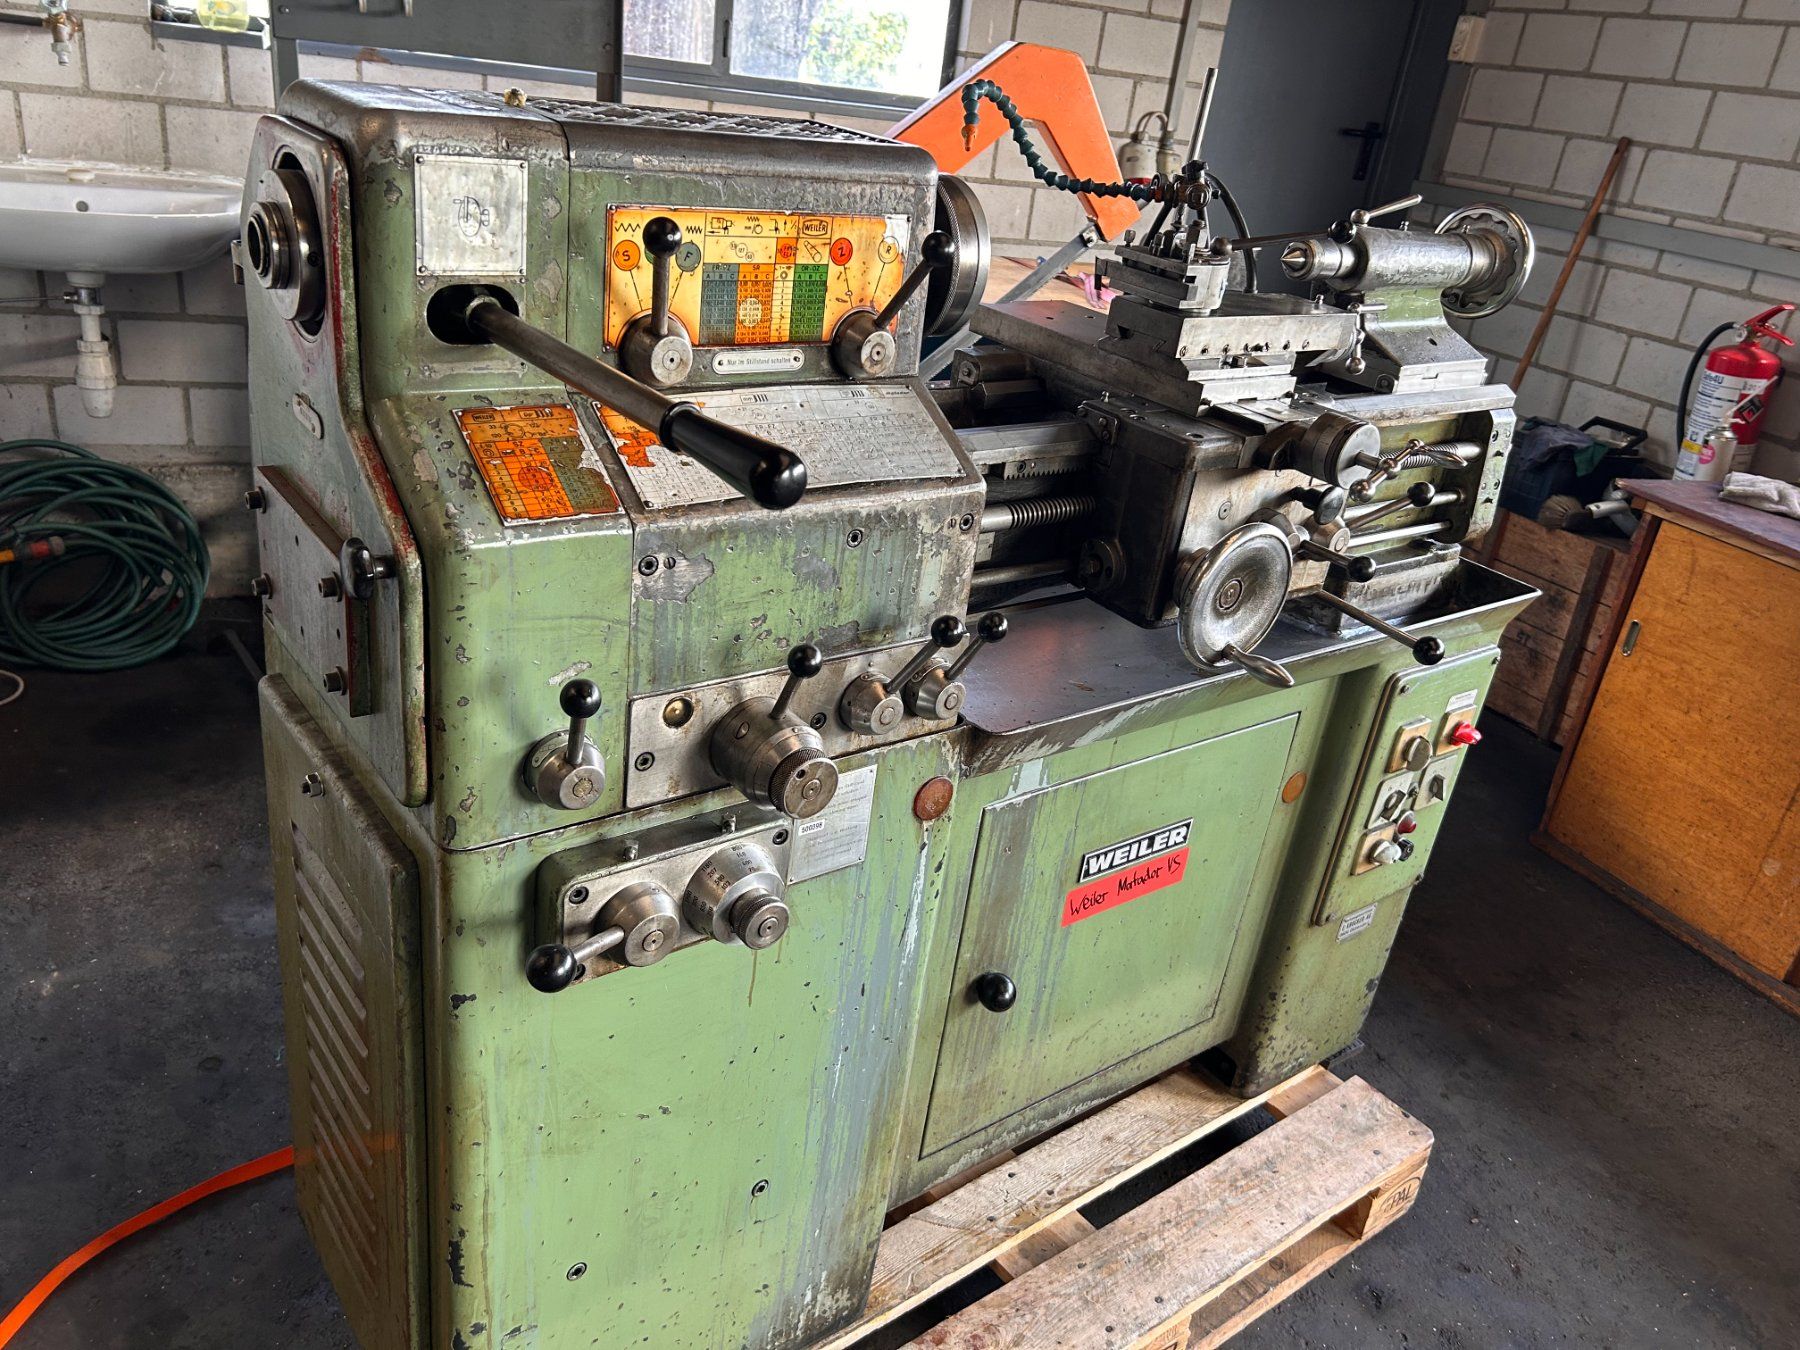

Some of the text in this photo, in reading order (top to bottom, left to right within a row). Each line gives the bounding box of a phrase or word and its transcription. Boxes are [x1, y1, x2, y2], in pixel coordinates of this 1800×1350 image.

[804, 223, 827, 233] WEILER
[838, 246, 846, 257] Z
[885, 245, 892, 255] R
[622, 250, 631, 262] S
[684, 251, 693, 262] F
[1088, 825, 1188, 875] WEILER
[1070, 854, 1182, 916] Weiler Matador VS
